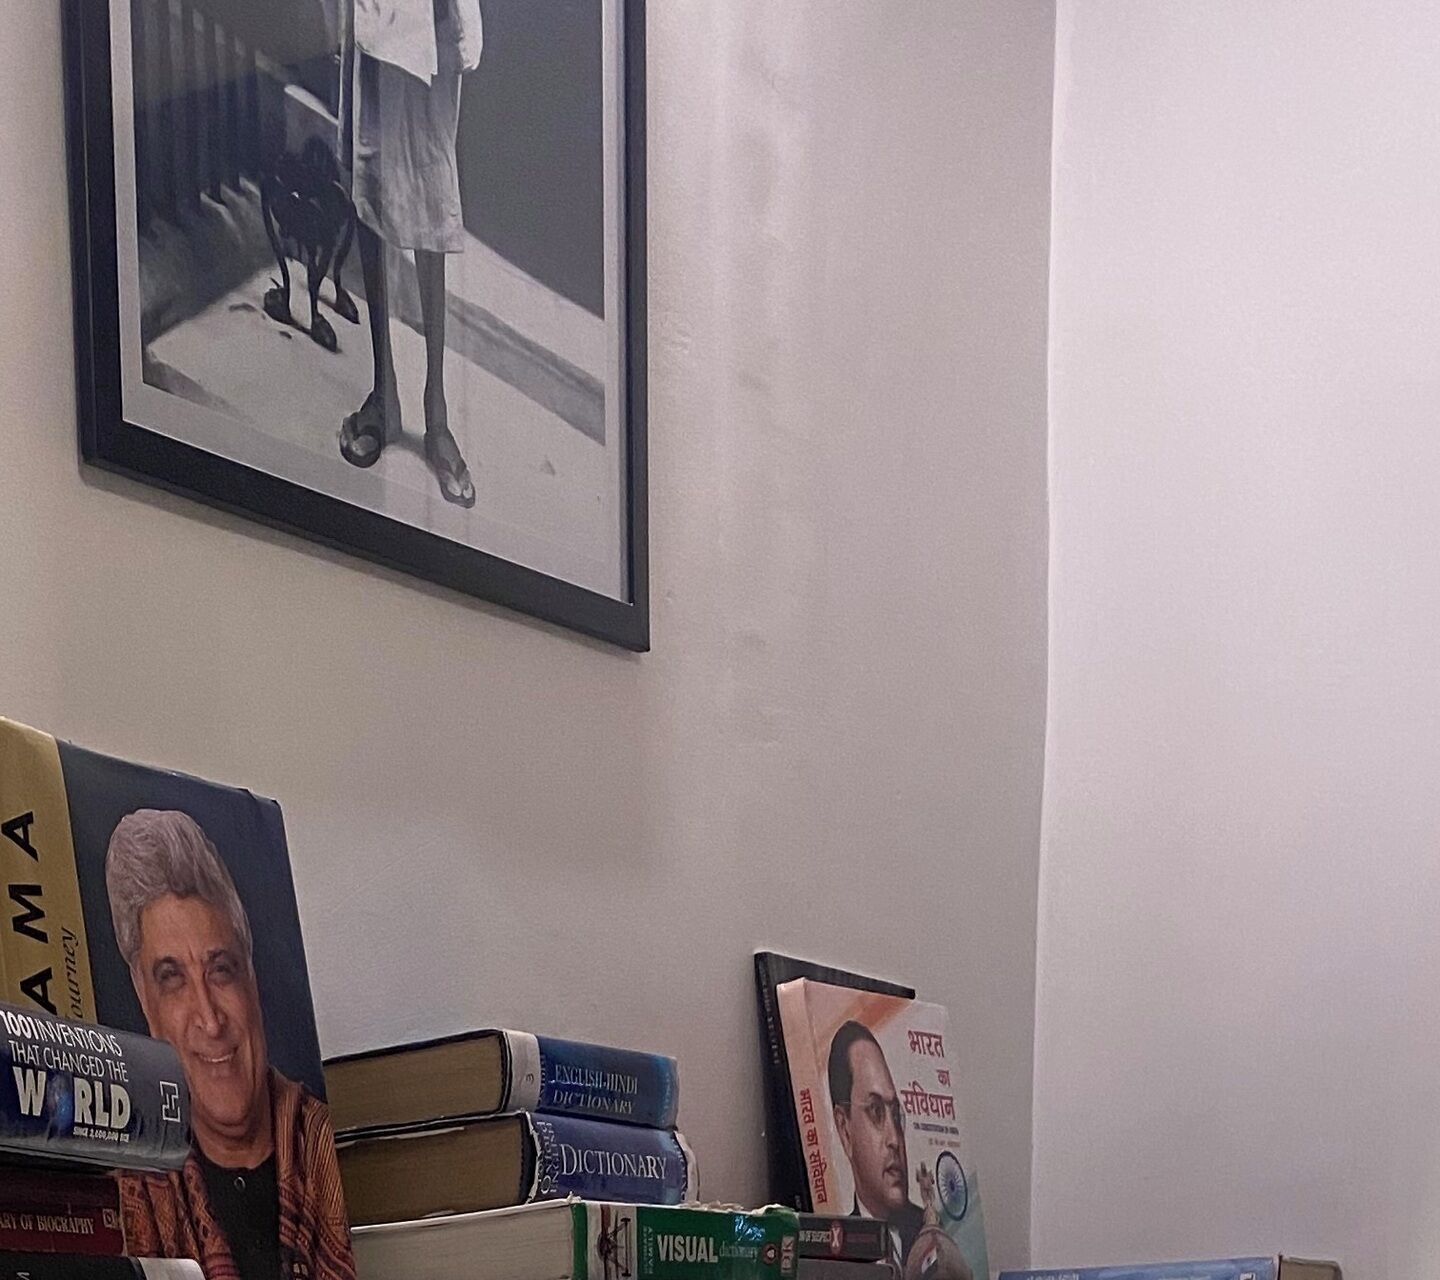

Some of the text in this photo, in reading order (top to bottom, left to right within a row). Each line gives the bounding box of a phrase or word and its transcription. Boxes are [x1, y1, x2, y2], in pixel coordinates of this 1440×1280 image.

[38, 1018, 122, 1057] INVENTIONS
[908, 1030, 945, 1058] भारत
[9, 1040, 129, 1082] THAT CHANGED THE
[936, 1069, 950, 1087] का
[901, 1081, 955, 1120] संविधान
[561, 1144, 668, 1180] DICTIONARY
[800, 1088, 828, 1204] भारत का संविधान
[657, 1234, 718, 1264] VISUAL
